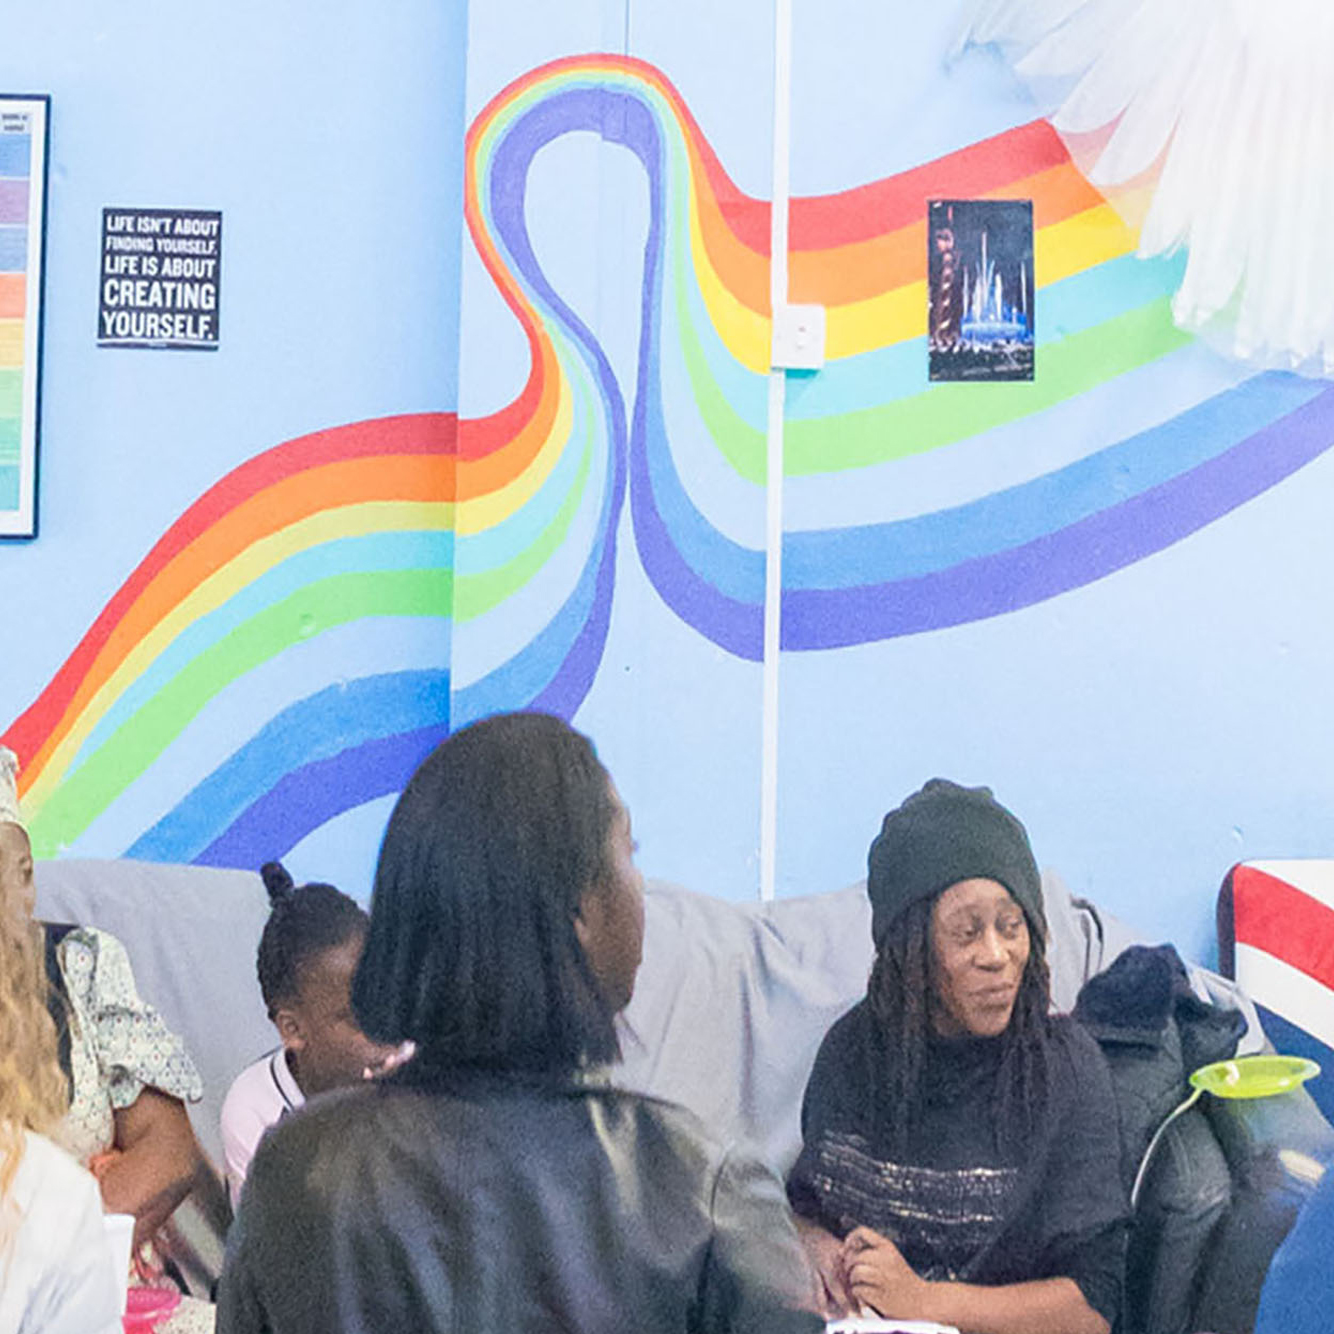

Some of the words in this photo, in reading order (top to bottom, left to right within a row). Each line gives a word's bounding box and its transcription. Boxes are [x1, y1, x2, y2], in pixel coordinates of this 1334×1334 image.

[107, 215, 134, 232] LIFE
[137, 216, 172, 234] ISN'T
[174, 218, 219, 236] ABOUT
[106, 236, 154, 251] FINDING
[156, 238, 217, 255] YOURSELF.
[105, 255, 138, 274] LIFE
[142, 256, 158, 276] IS
[161, 257, 216, 278] ABOUT
[104, 279, 216, 310] CREATING
[102, 310, 214, 340] YOURSELF.
